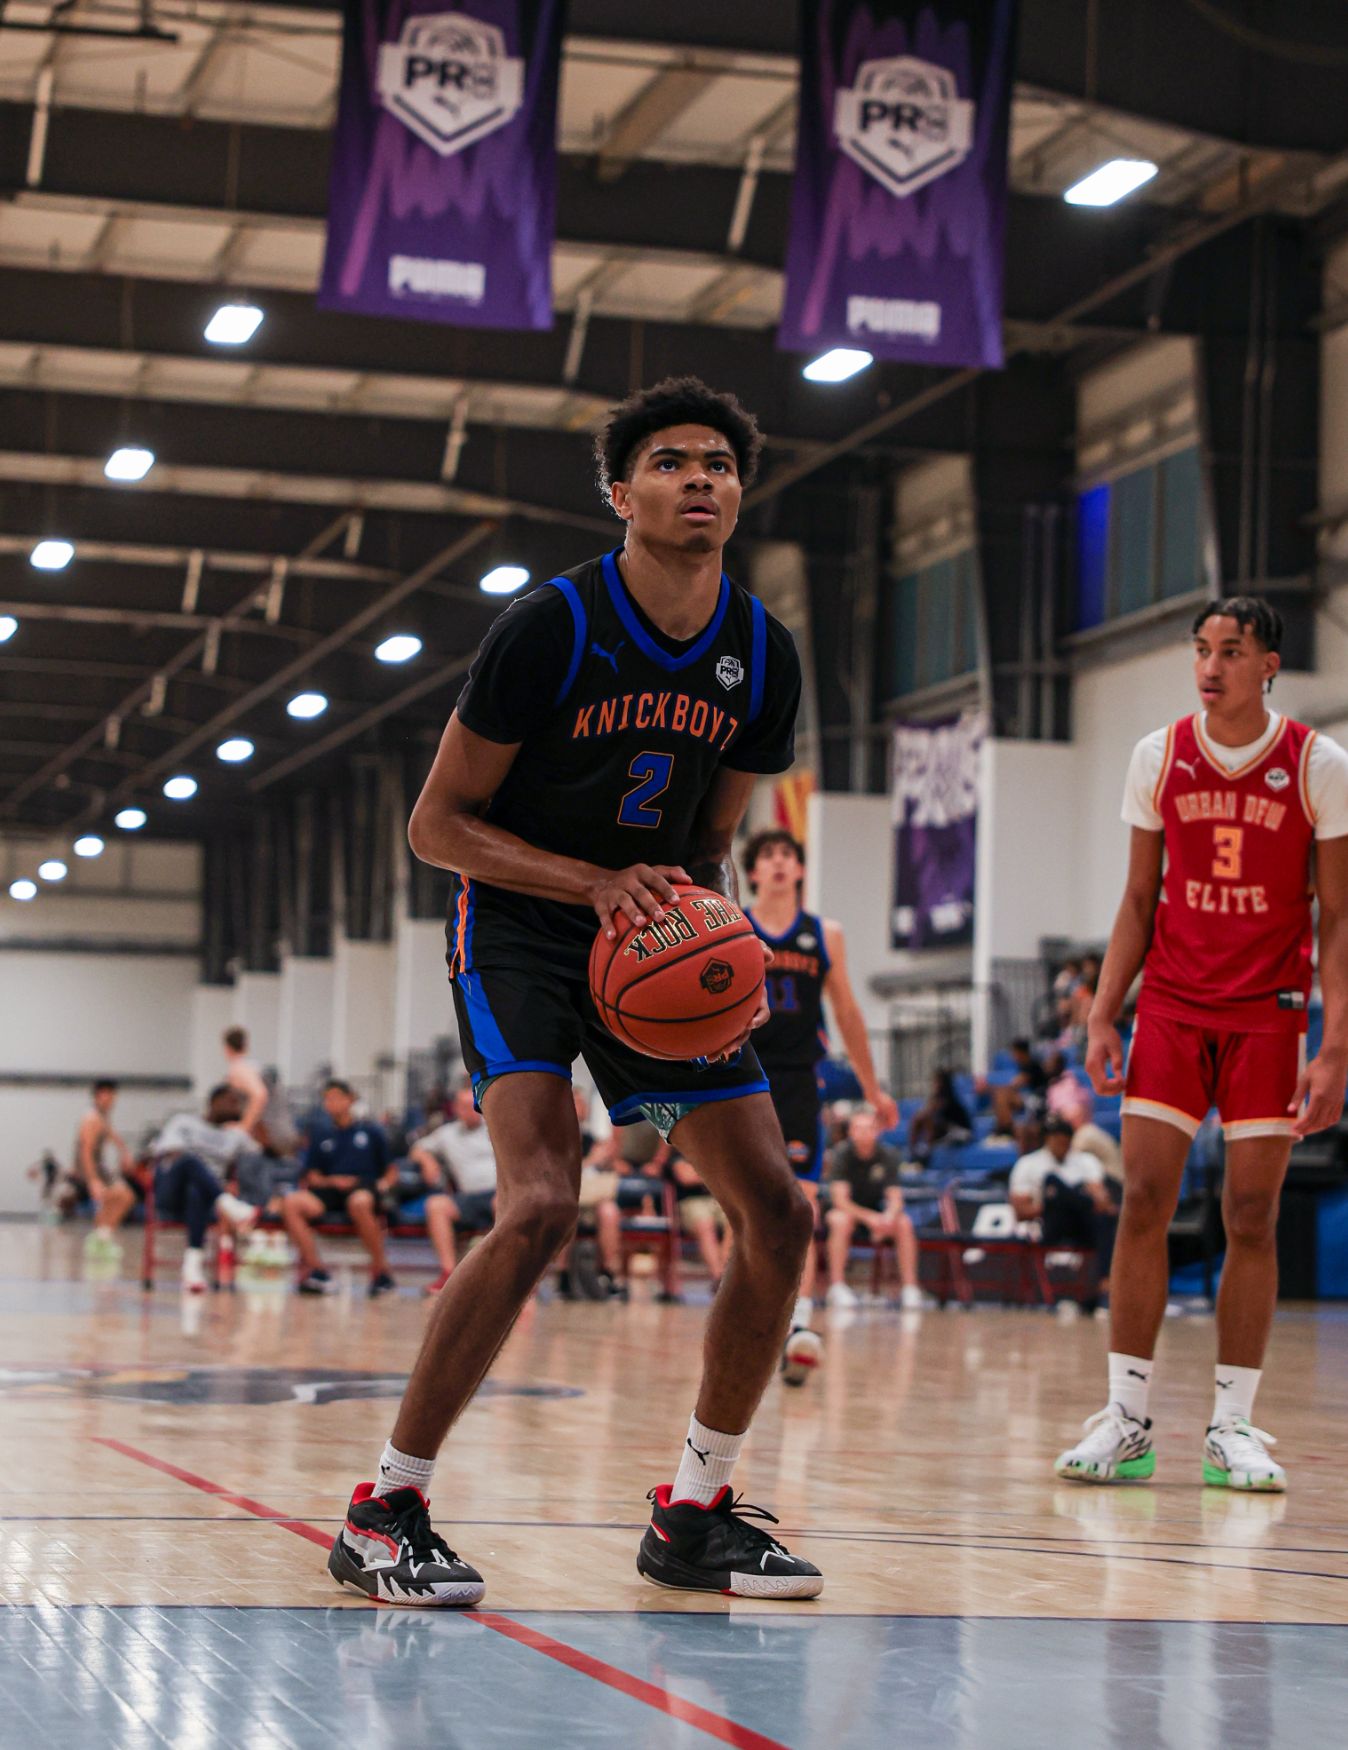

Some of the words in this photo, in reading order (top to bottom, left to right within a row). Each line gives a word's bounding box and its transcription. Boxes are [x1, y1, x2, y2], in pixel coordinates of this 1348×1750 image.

[572, 691, 740, 751] KNICKBOYZ
[616, 750, 675, 829] 2
[1211, 825, 1245, 880] 3
[690, 898, 742, 932] THE
[1185, 879, 1270, 915] ELITE
[627, 906, 699, 963] ROCK
